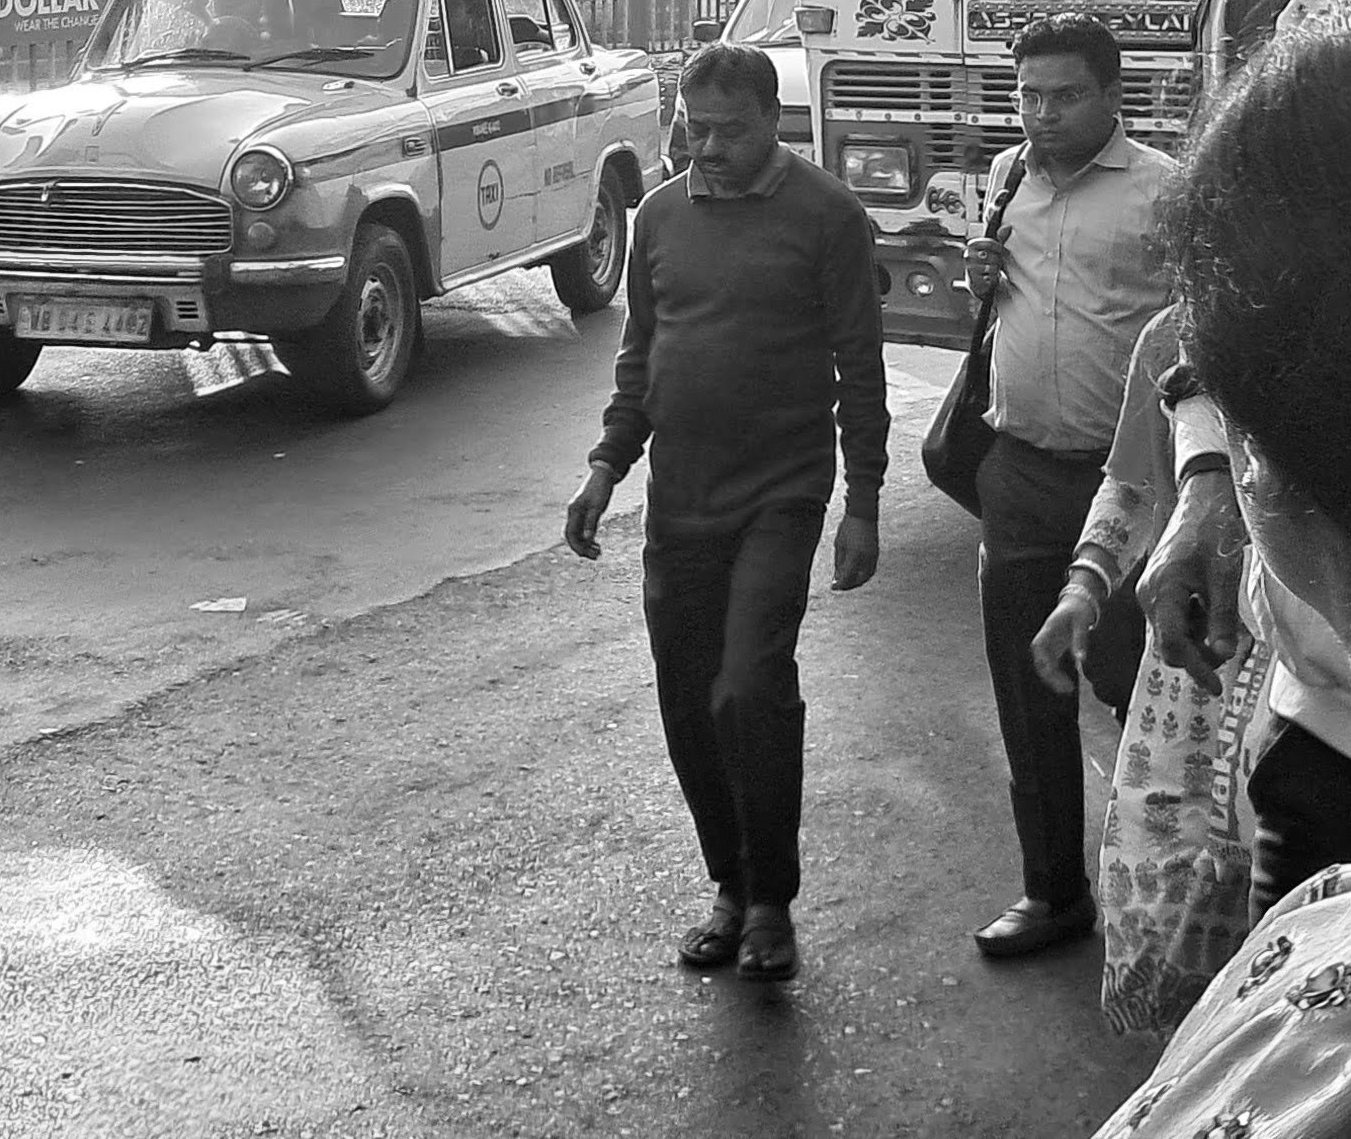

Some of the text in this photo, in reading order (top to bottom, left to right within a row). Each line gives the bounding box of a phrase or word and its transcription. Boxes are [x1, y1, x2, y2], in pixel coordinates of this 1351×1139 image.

[15, 14, 100, 32] WEAR THE CHANGE
[480, 182, 499, 207] TAXI
